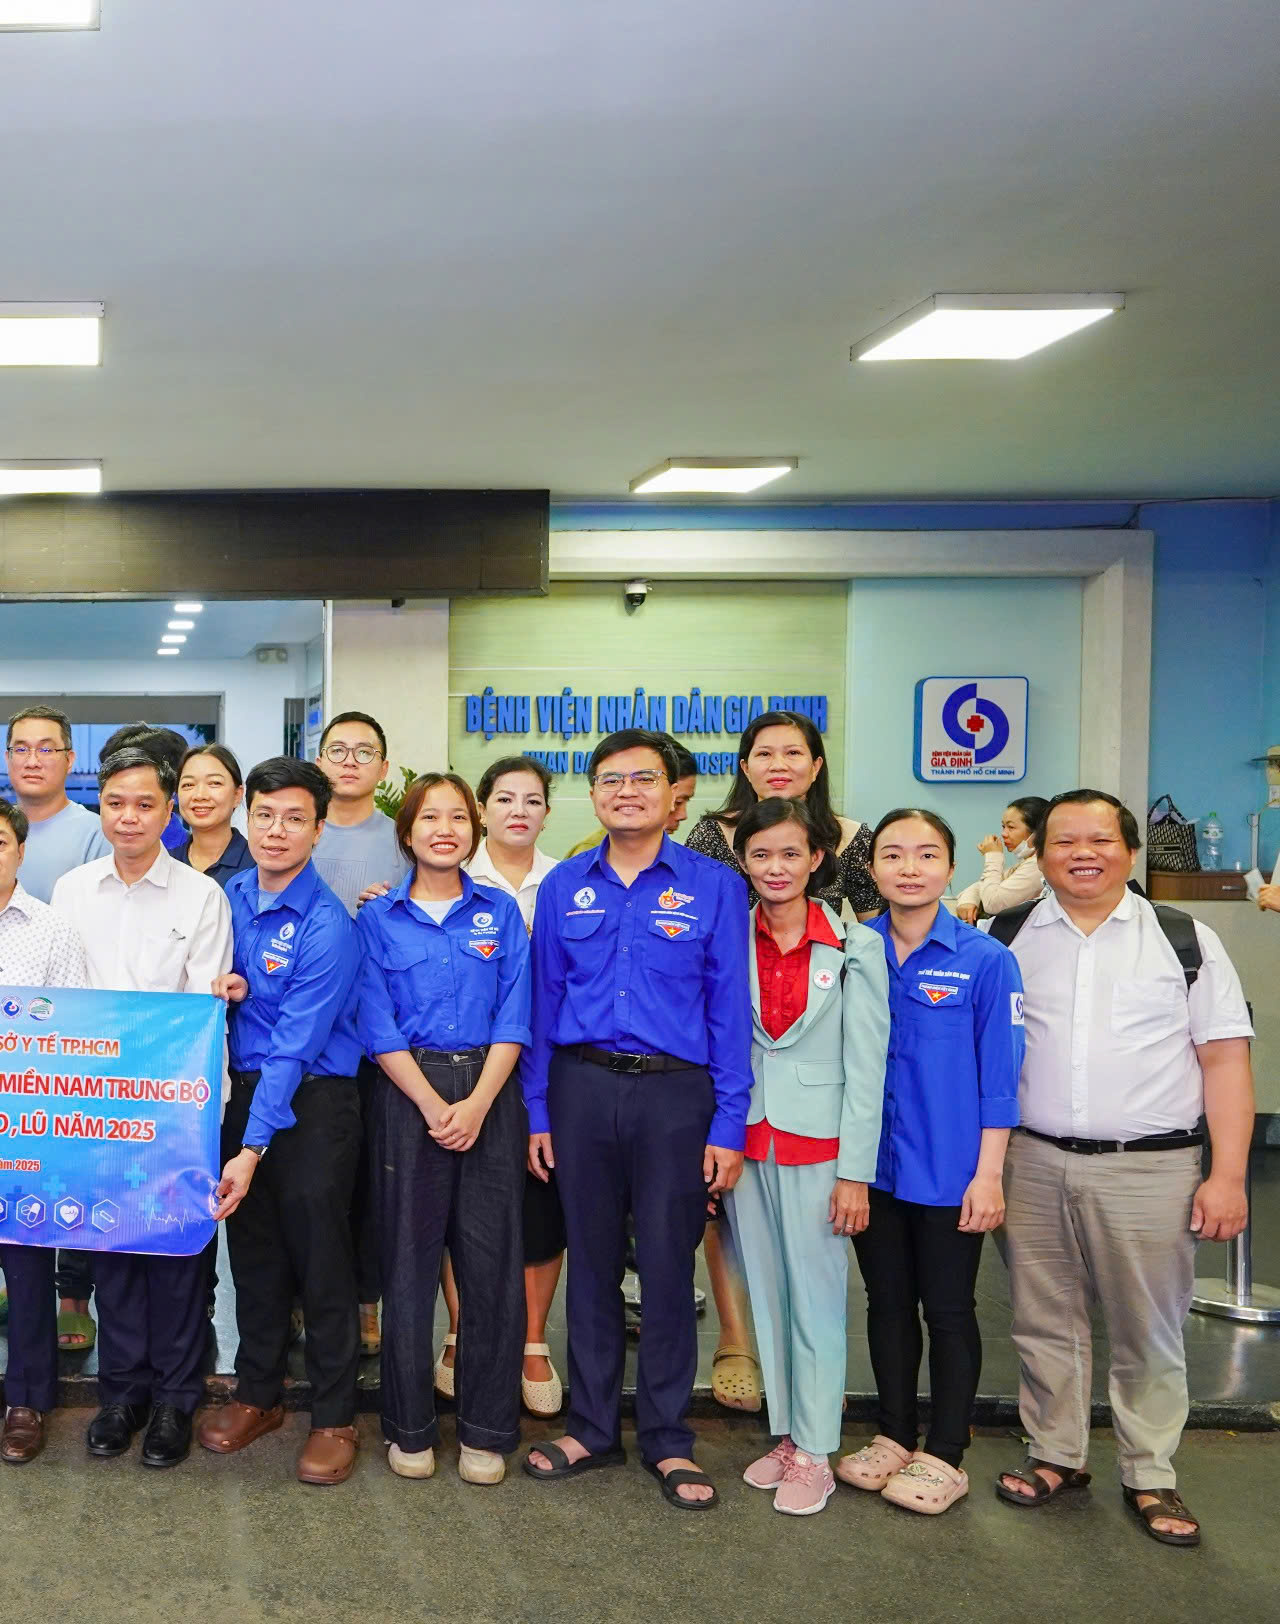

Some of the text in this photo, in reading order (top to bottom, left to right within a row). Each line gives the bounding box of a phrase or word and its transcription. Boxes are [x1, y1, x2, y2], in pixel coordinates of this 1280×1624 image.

[465, 686, 531, 741] BỆNH
[536, 686, 592, 741] VIỆN
[598, 687, 666, 733] NHÂN
[672, 687, 723, 733] DÂN
[931, 757, 972, 768] GIA ĐỊNH
[18, 1037, 33, 1052] Y
[36, 1034, 56, 1053] TẾ
[60, 1038, 120, 1057] TP.HCM
[54, 1075, 106, 1098] NAM
[106, 1077, 176, 1102] TRUNG
[179, 1078, 211, 1110] BỘ
[20, 1110, 48, 1136] LŨ
[53, 1113, 105, 1139] NĂM
[107, 1119, 156, 1142] 2025
[15, 1159, 41, 1172] 2025
